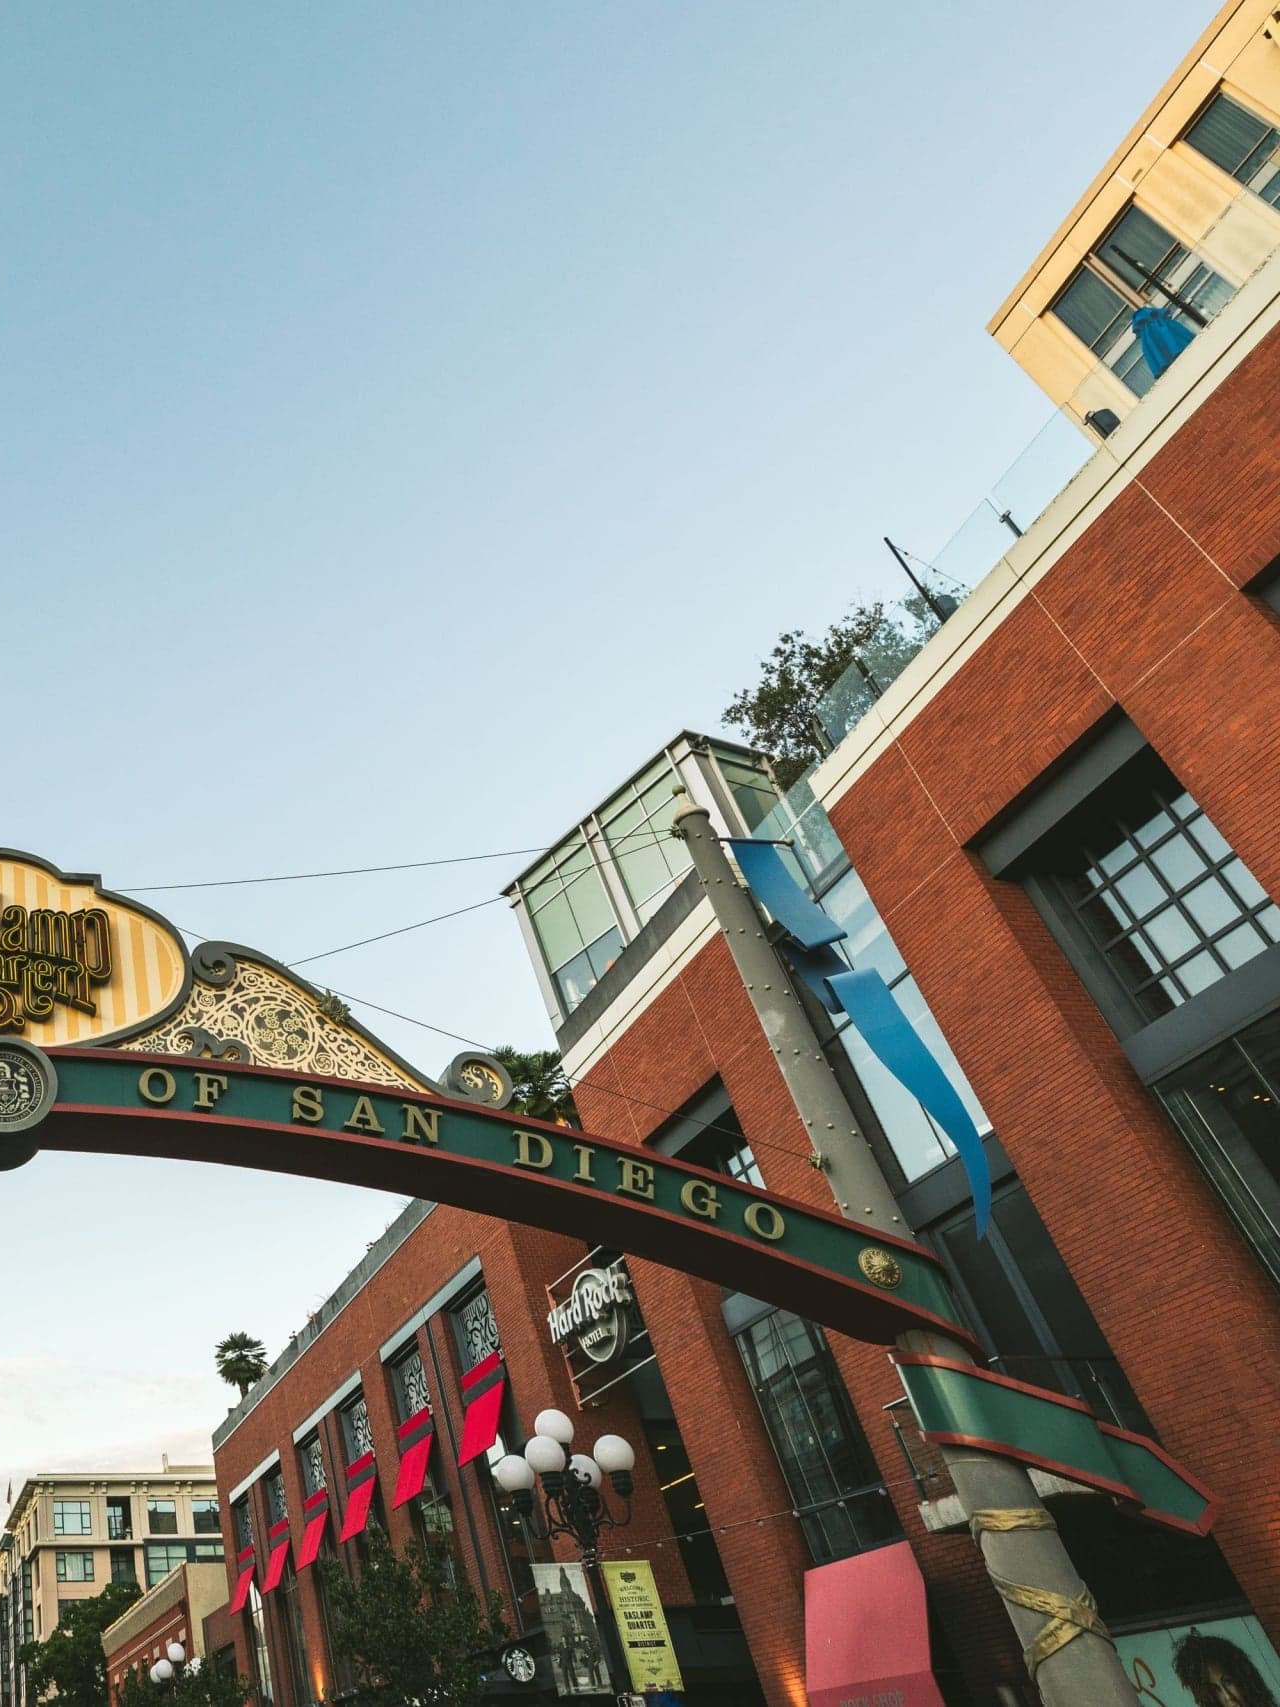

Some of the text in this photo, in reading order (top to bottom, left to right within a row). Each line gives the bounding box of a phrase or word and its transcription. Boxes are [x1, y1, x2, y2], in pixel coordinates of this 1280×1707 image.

[138, 1068, 228, 1109] OF
[291, 1085, 444, 1144] SAN
[511, 1130, 786, 1242] DIEGO
[547, 1267, 624, 1344] Hard Rock
[581, 1328, 605, 1348] HOTEL
[623, 1610, 654, 1620] GASLAMP
[627, 1620, 657, 1630] QUARTER
